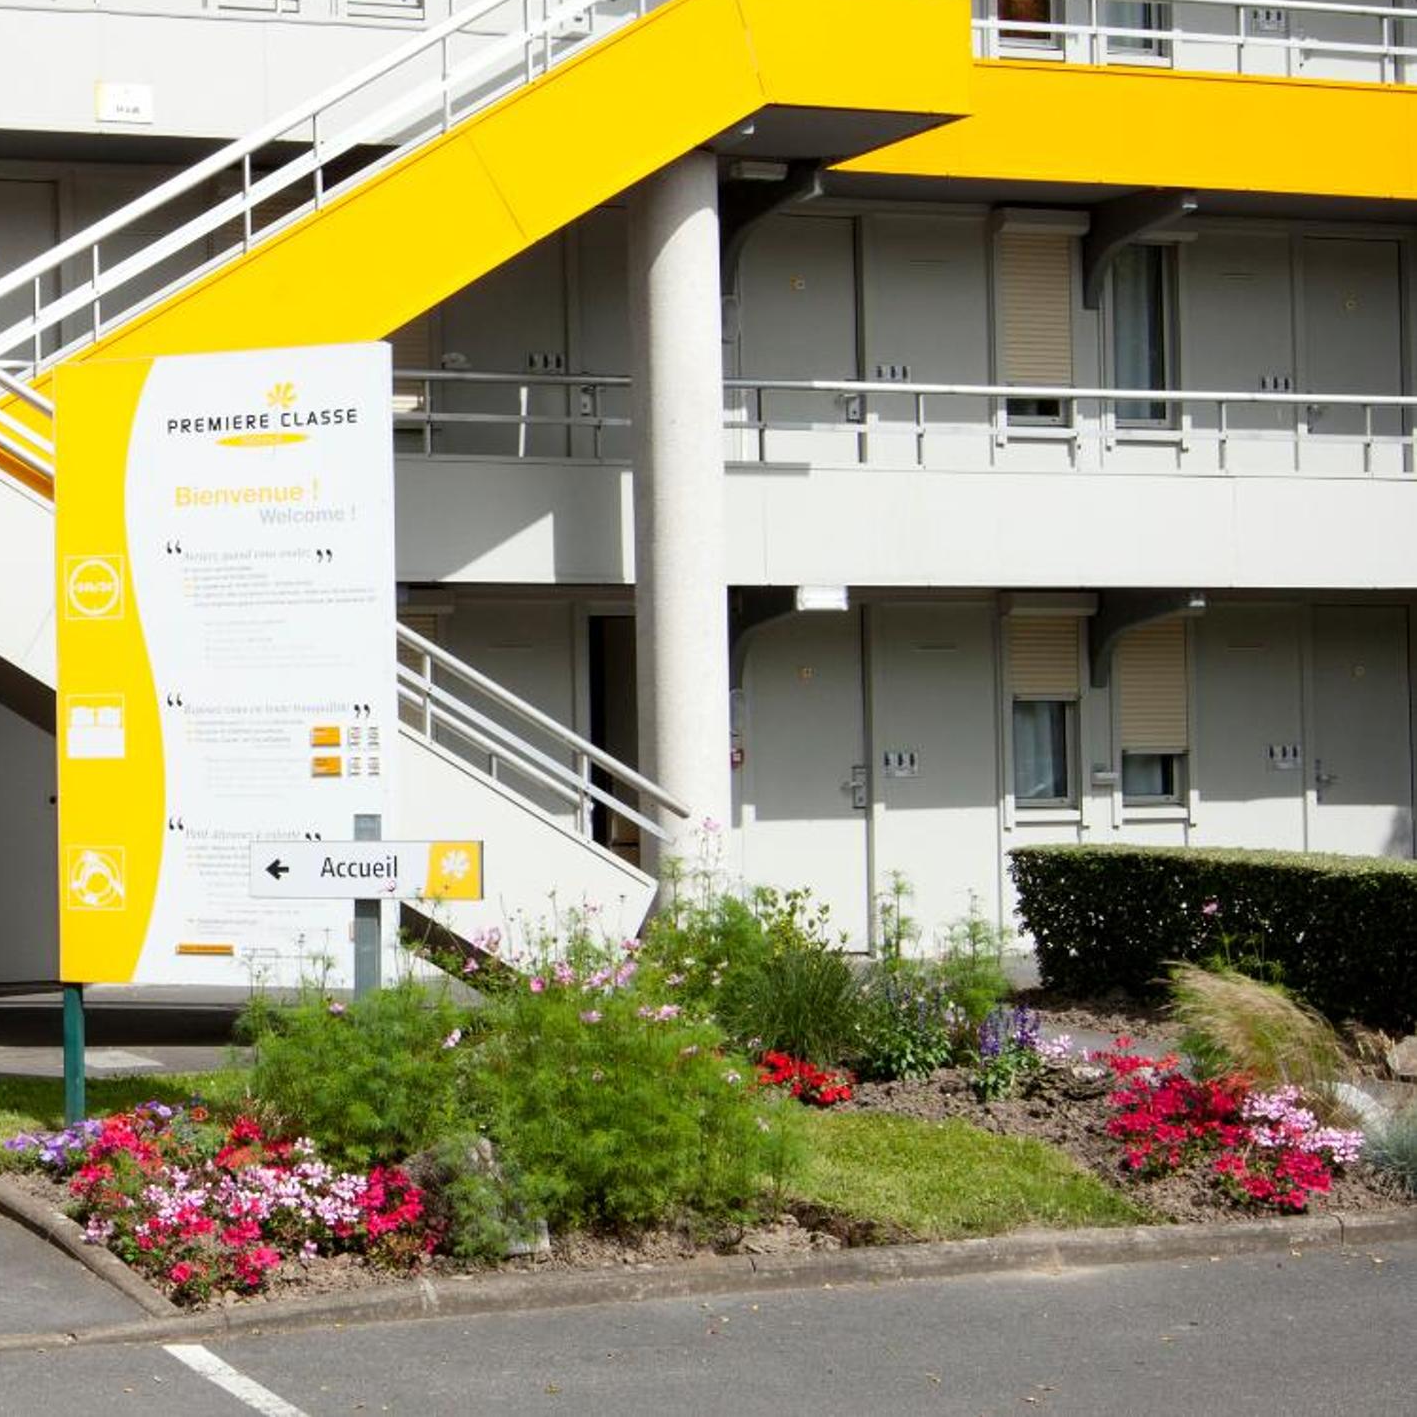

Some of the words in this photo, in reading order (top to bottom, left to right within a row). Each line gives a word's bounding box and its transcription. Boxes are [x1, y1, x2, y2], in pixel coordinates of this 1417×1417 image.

[168, 414, 269, 433] PREMIERE
[281, 409, 357, 428] CLASSE
[175, 485, 304, 509] Bienvenue
[259, 506, 346, 525] Welcome
[320, 855, 398, 879] Accueil
